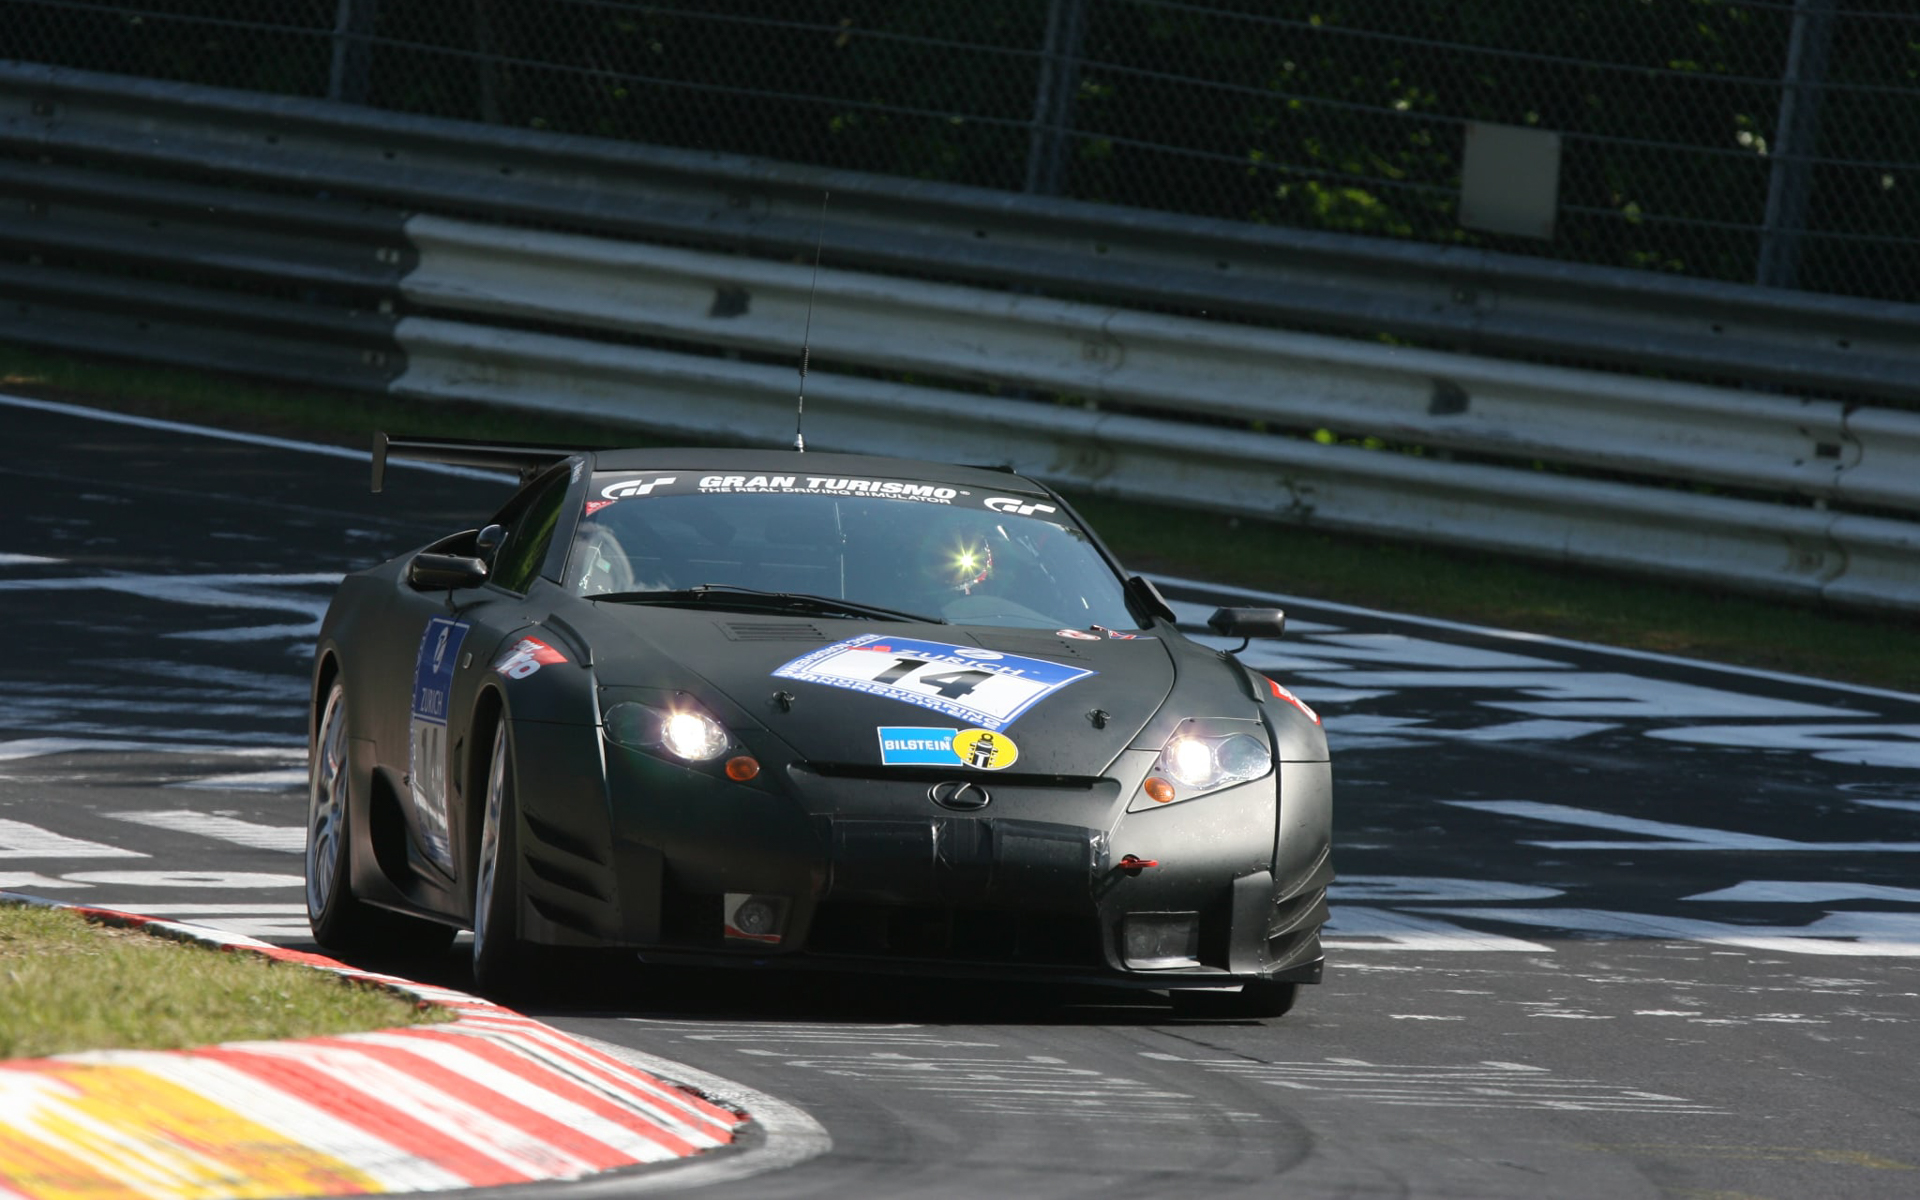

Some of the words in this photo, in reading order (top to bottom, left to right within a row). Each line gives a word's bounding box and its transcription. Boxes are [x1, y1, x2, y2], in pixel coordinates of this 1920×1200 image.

[699, 476, 797, 489] GRAN
[806, 477, 957, 500] TURISMO
[783, 487, 851, 496] DRIVING
[854, 491, 952, 505] SIMULATOR
[896, 649, 1026, 677] ZURICH
[872, 658, 995, 700] 14
[884, 739, 951, 751] BILSTEIN
